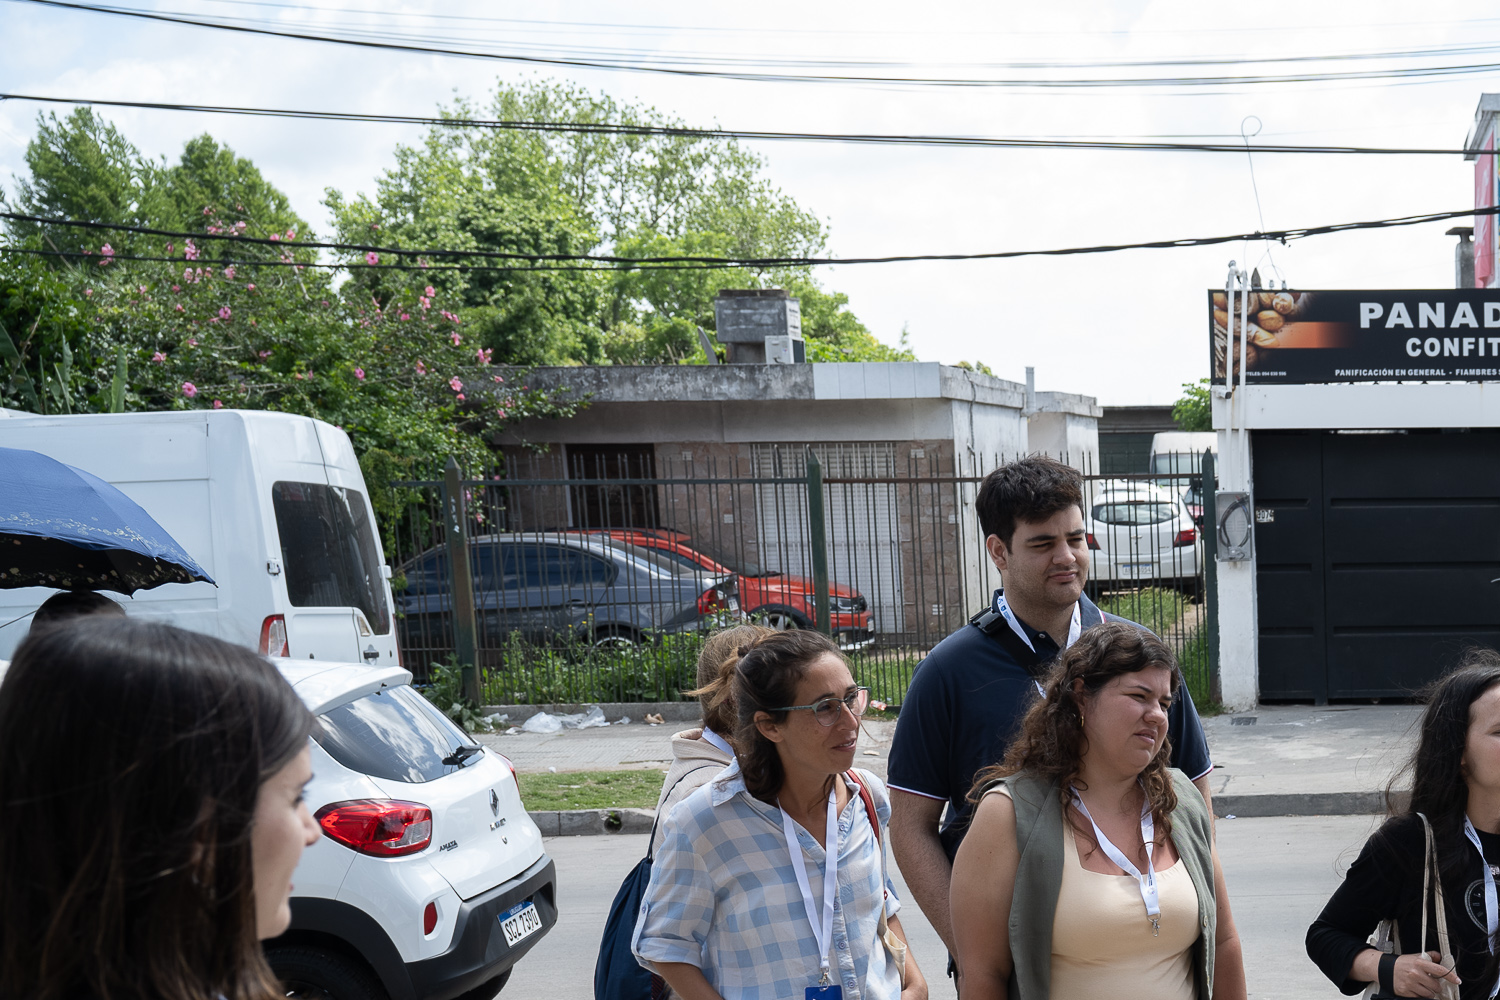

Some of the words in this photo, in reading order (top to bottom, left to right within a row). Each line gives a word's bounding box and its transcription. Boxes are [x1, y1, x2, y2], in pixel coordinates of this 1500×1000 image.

[1335, 367, 1394, 377] PANIFICACIÓN
[1395, 368, 1407, 376] EN
[1408, 368, 1446, 376] GENERAL
[1455, 368, 1497, 376] FIAMBRES
[504, 918, 522, 941] SCZ
